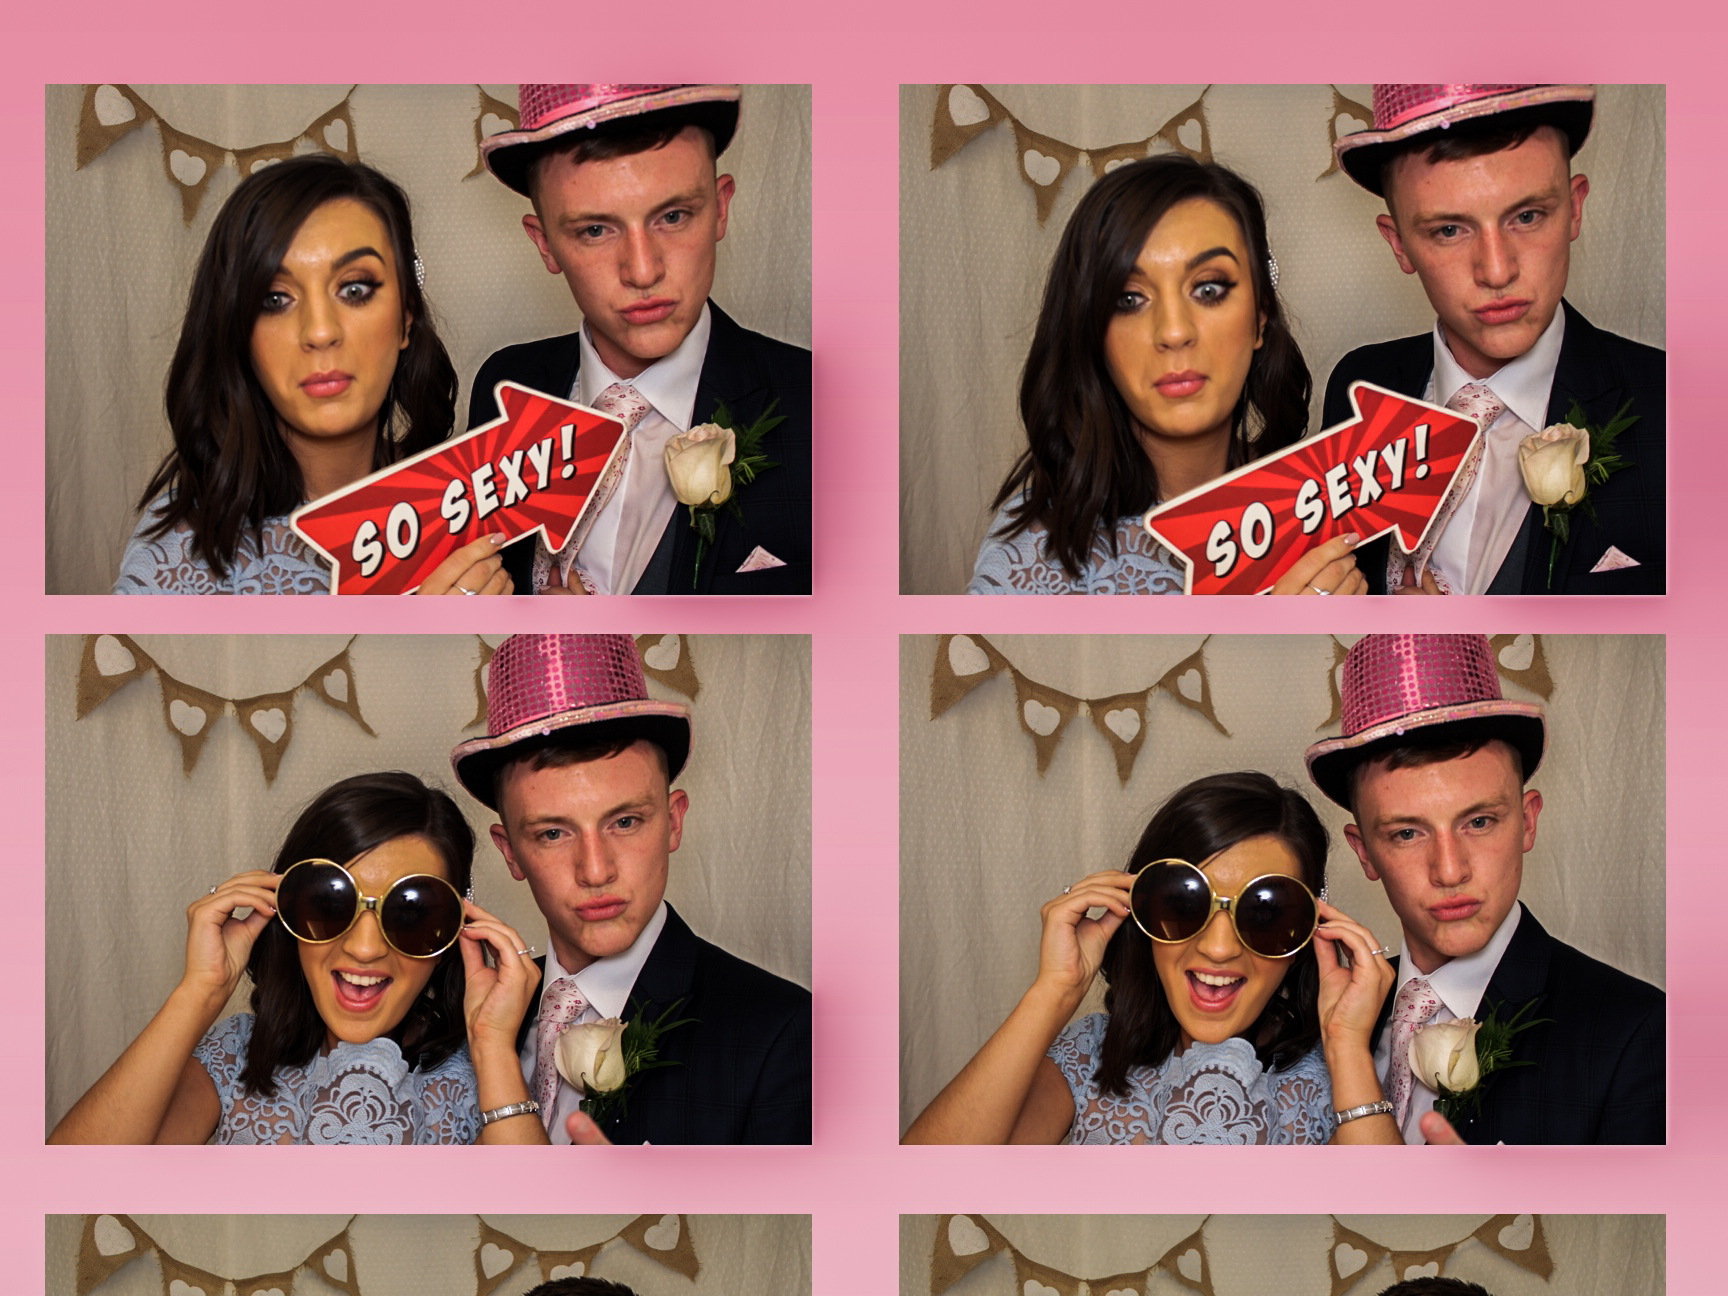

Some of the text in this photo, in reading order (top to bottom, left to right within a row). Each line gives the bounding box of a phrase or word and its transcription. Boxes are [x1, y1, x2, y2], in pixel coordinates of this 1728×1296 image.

[352, 423, 577, 578] SO SEXY!
[1206, 423, 1431, 578] SO SEXY!
